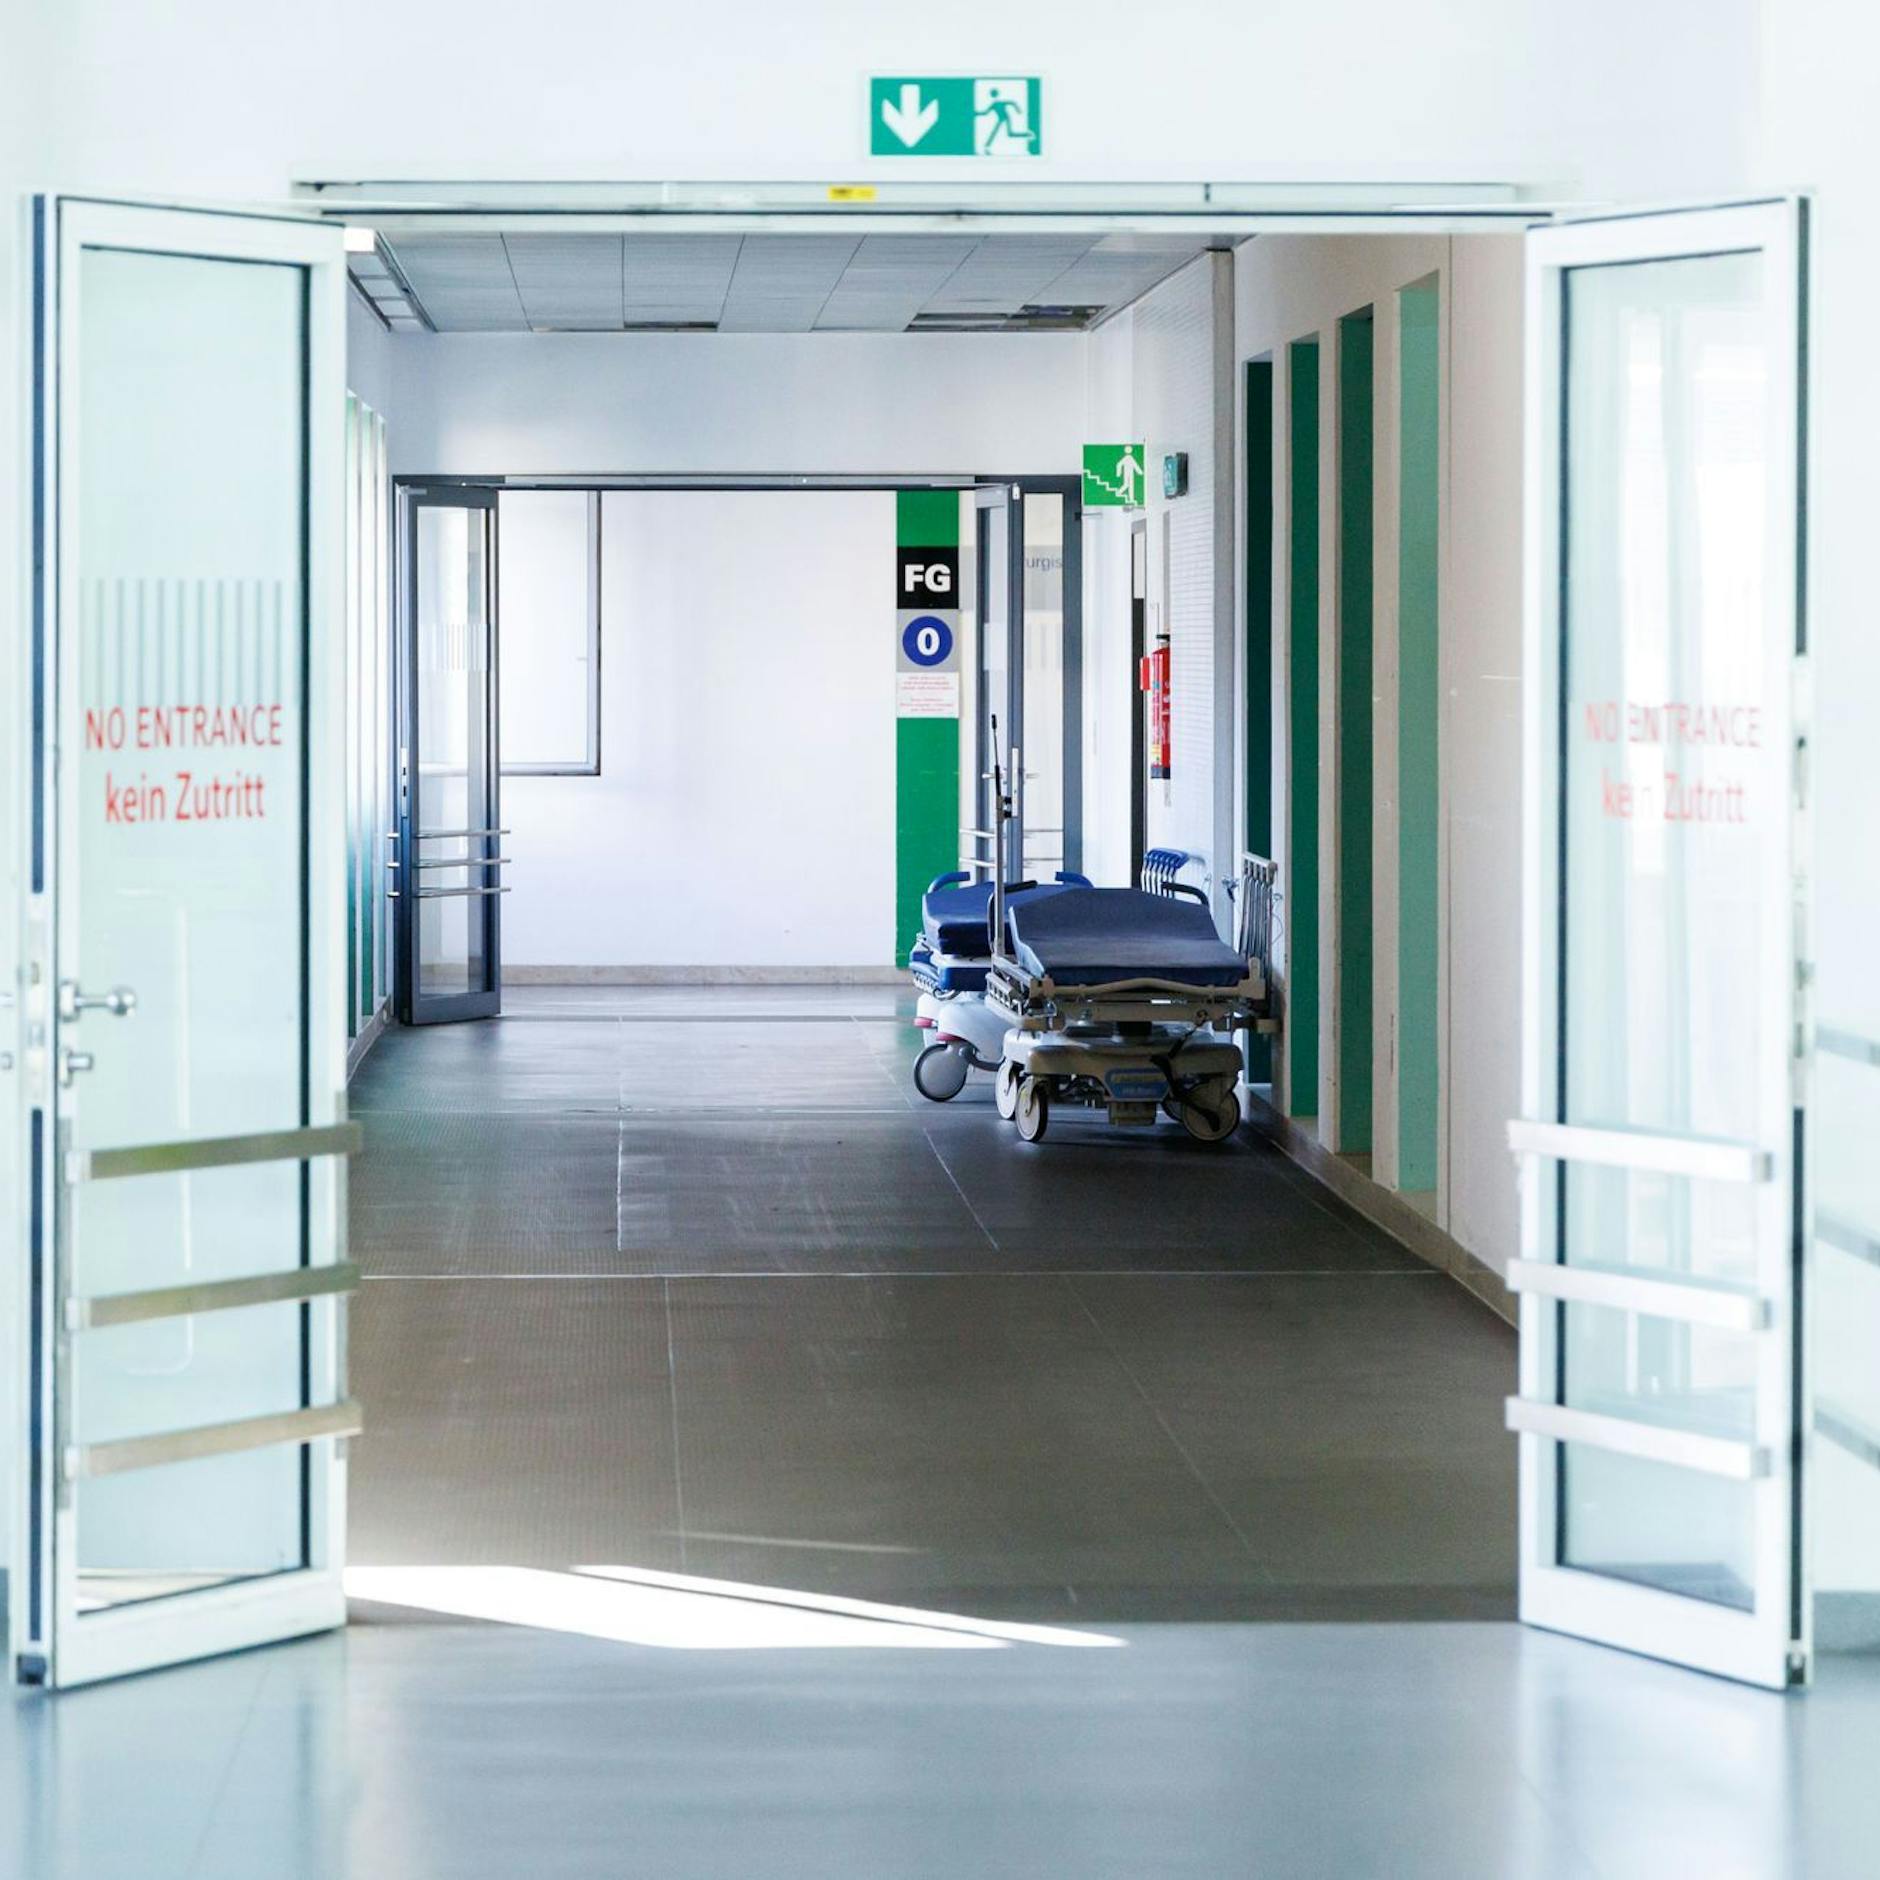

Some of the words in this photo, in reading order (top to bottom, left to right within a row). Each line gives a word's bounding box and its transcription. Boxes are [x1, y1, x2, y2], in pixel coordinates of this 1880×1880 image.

[904, 563, 951, 592] FG
[86, 706, 125, 749] NO
[136, 703, 282, 748] ENTRANCE
[1586, 702, 1617, 742] NO
[1629, 703, 1760, 747] ENTRANCE
[105, 771, 165, 822] kein
[175, 771, 265, 820] Zutritt
